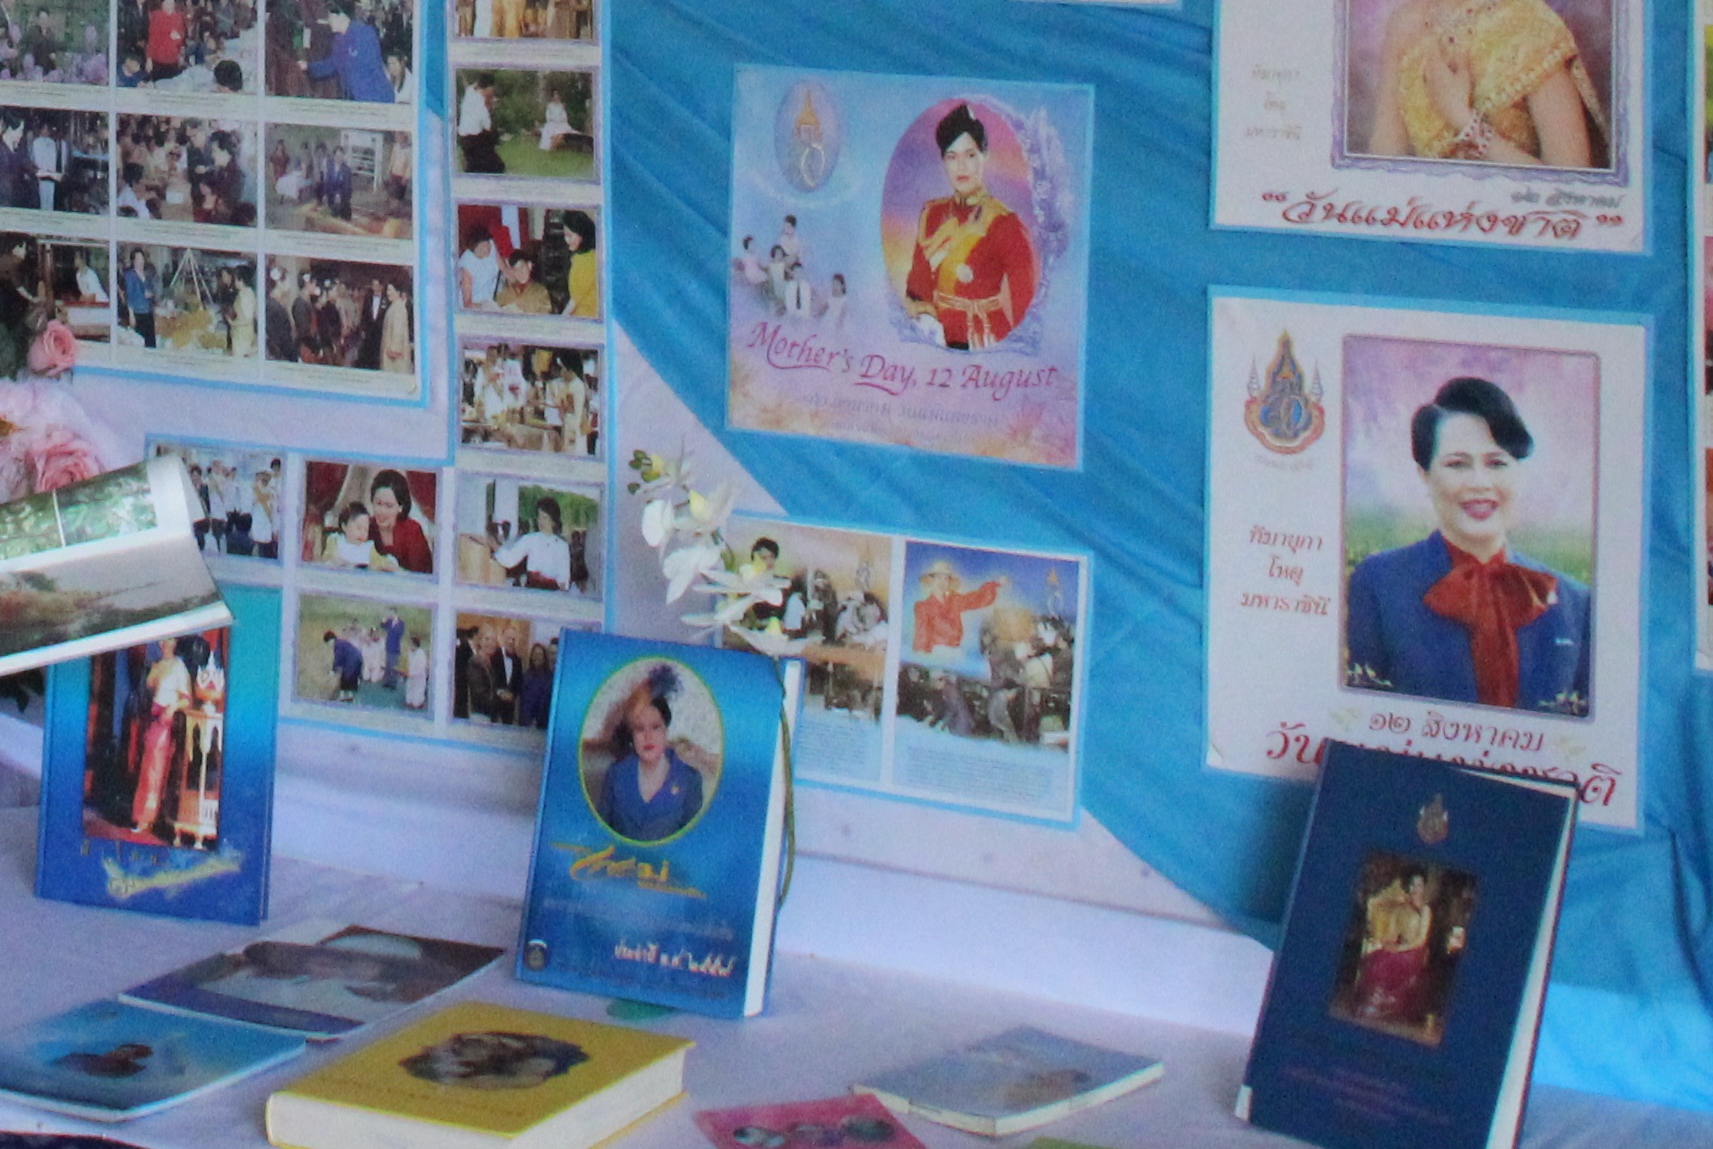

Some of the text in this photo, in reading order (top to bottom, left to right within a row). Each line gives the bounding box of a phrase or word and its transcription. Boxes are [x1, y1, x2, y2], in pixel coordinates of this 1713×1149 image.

[747, 321, 855, 373] Mother's
[925, 367, 953, 389] 12
[959, 362, 1059, 402] August
[1369, 710, 1545, 753] ๑๒ สิงหาคม
